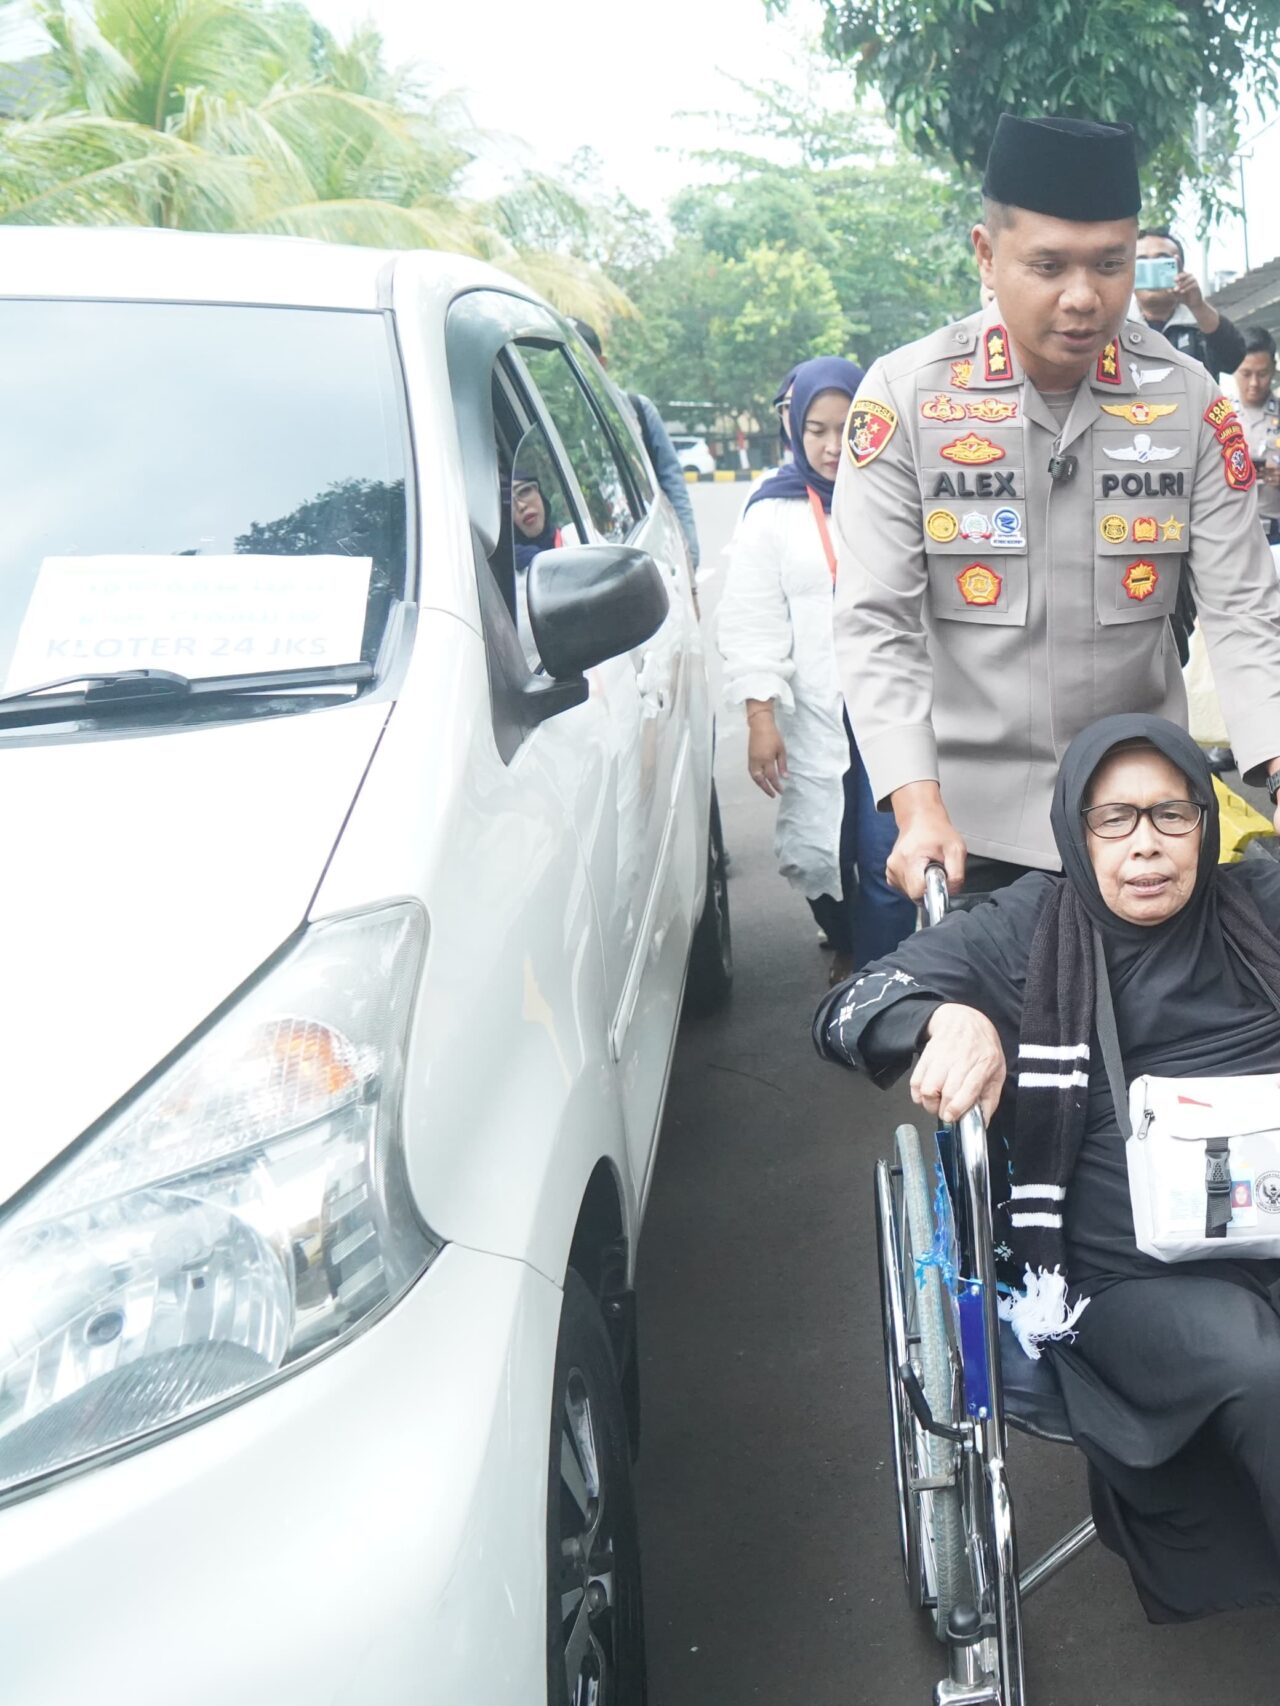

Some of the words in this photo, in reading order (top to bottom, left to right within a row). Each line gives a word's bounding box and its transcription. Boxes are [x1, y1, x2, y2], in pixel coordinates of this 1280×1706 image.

[932, 471, 1017, 497] ALEX
[1102, 471, 1184, 498] POLRI
[46, 637, 196, 658] KLOTER
[210, 637, 255, 657] 24
[266, 636, 328, 657] JKS
